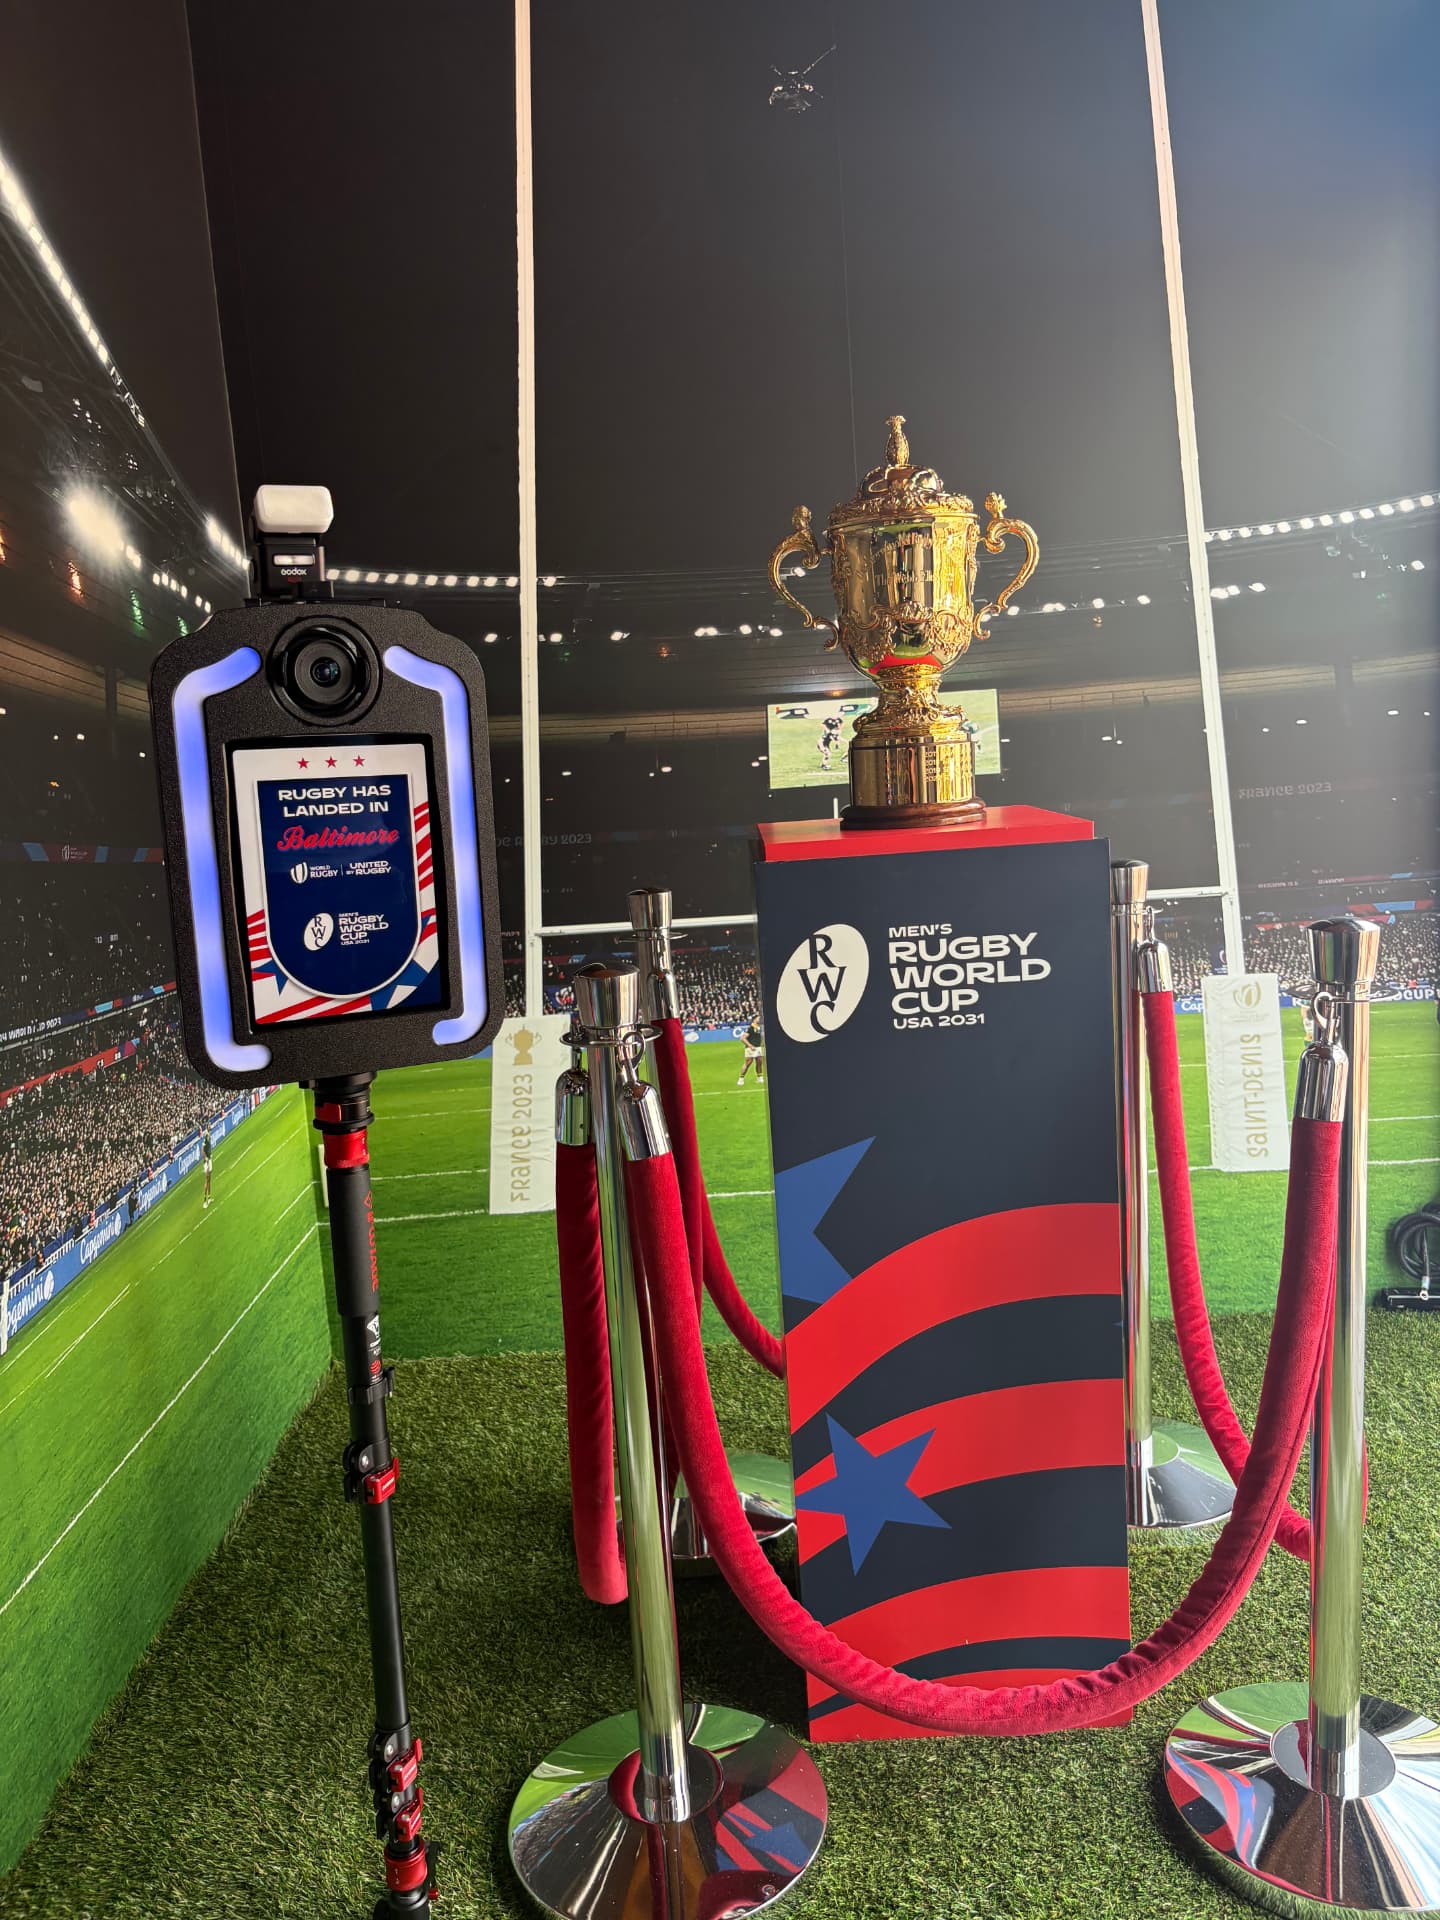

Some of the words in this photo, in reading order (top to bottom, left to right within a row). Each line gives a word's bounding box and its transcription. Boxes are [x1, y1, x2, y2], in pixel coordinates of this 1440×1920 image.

[278, 786, 347, 801] RUGBY
[352, 784, 391, 797] HAS
[283, 804, 366, 818] LANDED
[370, 802, 389, 813] IN
[277, 825, 400, 851] Baltimore
[560, 832, 592, 845] 2023
[349, 861, 390, 870] UNITED
[356, 867, 392, 876] RUGBY
[310, 870, 338, 878] RUGBY
[339, 914, 384, 926] RUGBY
[340, 922, 389, 933] WORLD
[340, 932, 368, 941] CUP
[888, 923, 953, 938] MEN'S
[888, 932, 1038, 964] RUGBY
[890, 958, 1051, 990] WORLD
[891, 988, 980, 1015] CUP
[893, 1016, 933, 1030] USA
[938, 1013, 985, 1028] 2031
[512, 1073, 533, 1119] 2023
[80, 1217, 116, 1264] Capgemini
